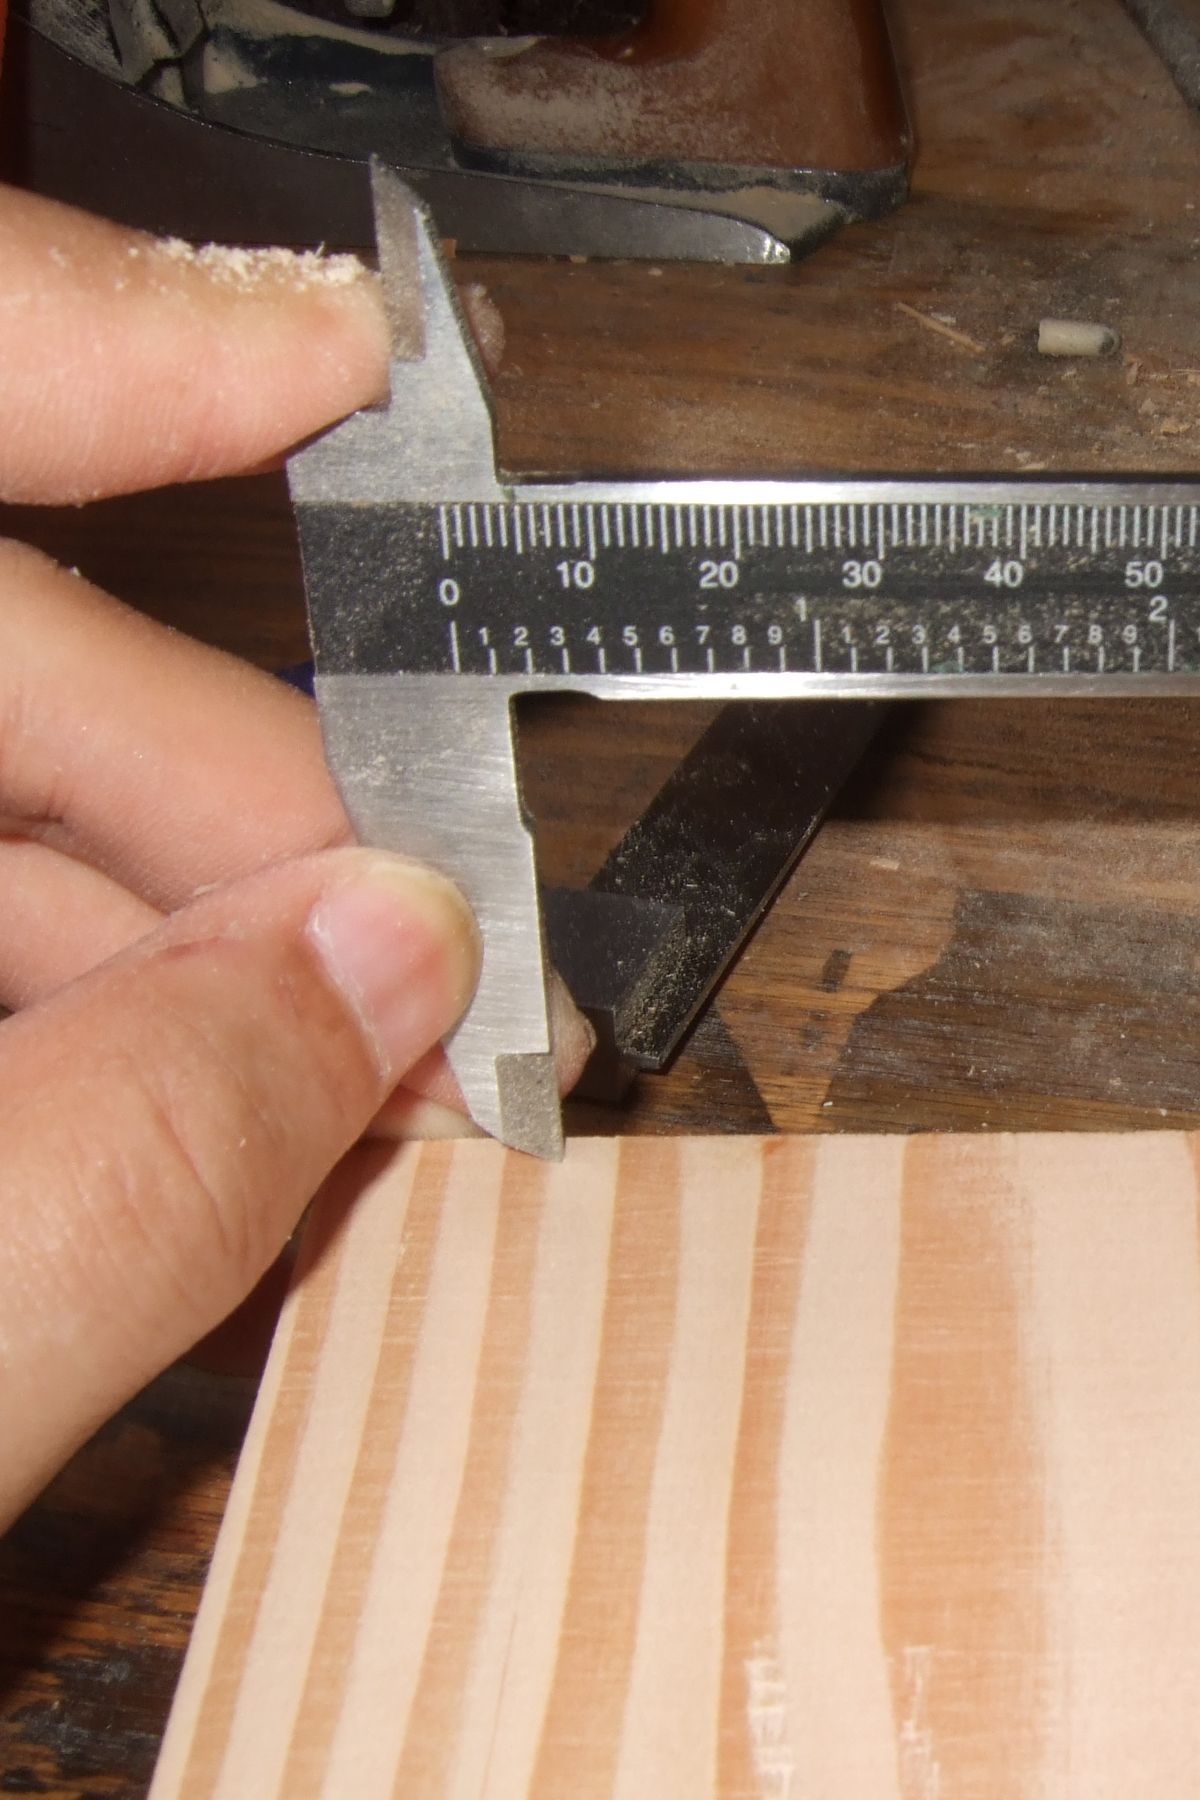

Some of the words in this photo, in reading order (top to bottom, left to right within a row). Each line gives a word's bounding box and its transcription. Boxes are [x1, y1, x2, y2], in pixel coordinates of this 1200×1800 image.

[556, 560, 594, 589] 10
[700, 560, 738, 589] 20
[842, 560, 882, 589] 30
[984, 560, 1024, 588] 40
[1124, 560, 1164, 588] 50
[439, 578, 460, 606] 0
[1148, 596, 1168, 623] 2
[478, 626, 489, 646] 1
[514, 626, 529, 646] 2
[550, 626, 565, 646] 3
[586, 626, 601, 646] 4
[622, 626, 638, 646] 5
[659, 626, 674, 646] 6
[696, 626, 710, 646] 7
[731, 626, 746, 646] 8
[767, 626, 783, 646] 9
[841, 625, 852, 645] 1
[876, 625, 890, 645] 2
[912, 625, 926, 645] 3
[947, 625, 961, 645] 4
[983, 625, 997, 645] 5
[1018, 625, 1033, 645] 6
[1054, 625, 1068, 645] 7
[1088, 625, 1102, 645] 8
[1123, 625, 1138, 645] 9
